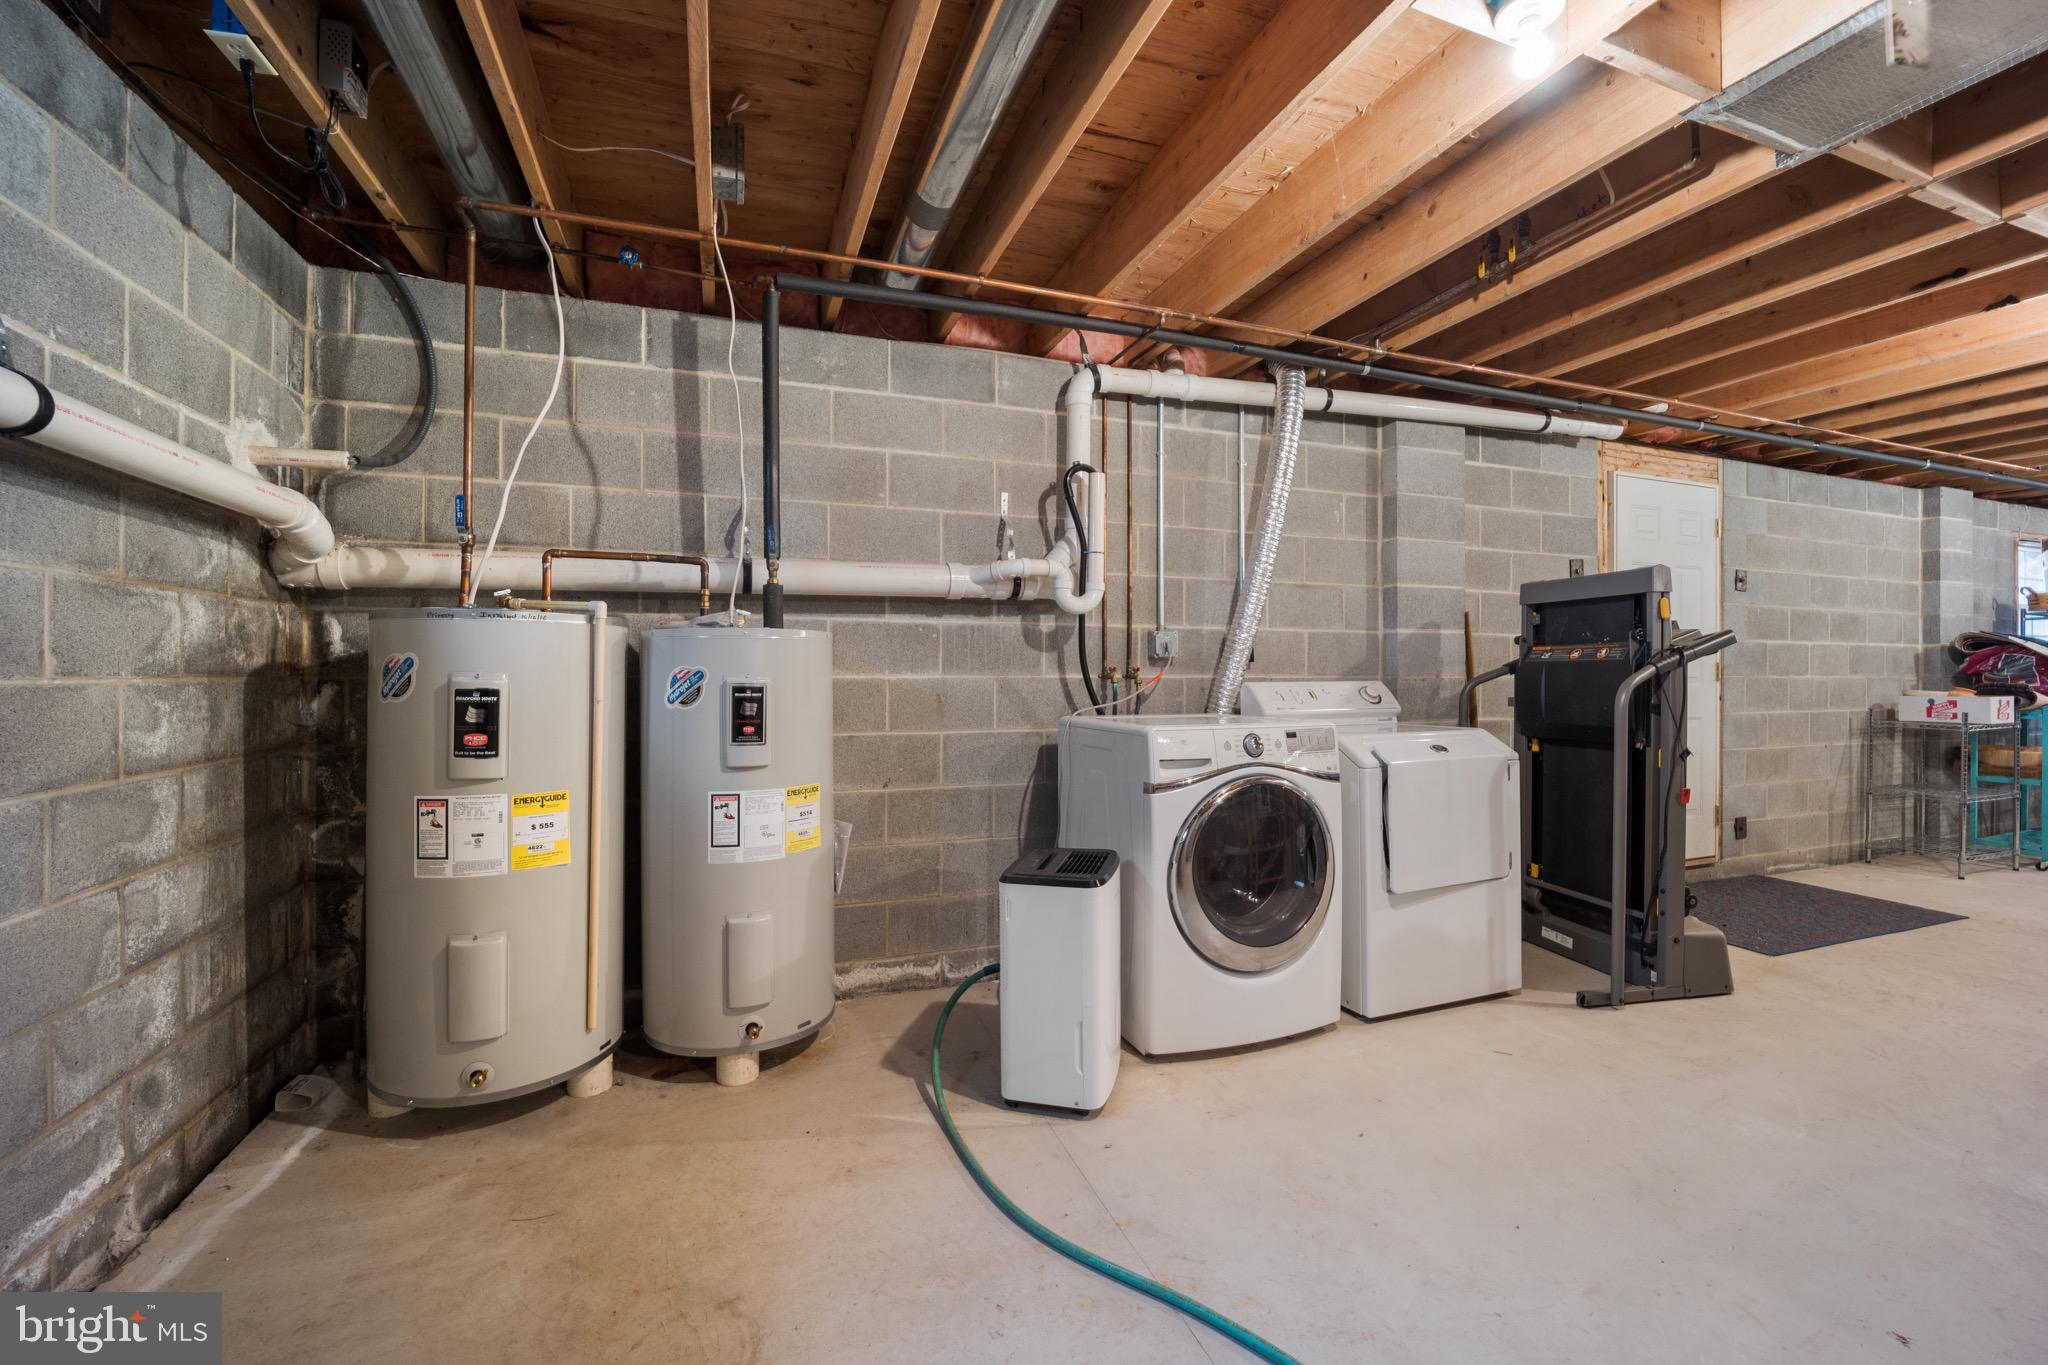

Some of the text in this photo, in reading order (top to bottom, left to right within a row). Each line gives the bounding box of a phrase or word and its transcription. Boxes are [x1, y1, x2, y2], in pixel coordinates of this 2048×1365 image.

[669, 679, 691, 702] Hydrojet
[513, 793, 567, 807] ENERGYGUIDE
[539, 821, 555, 830] 555
